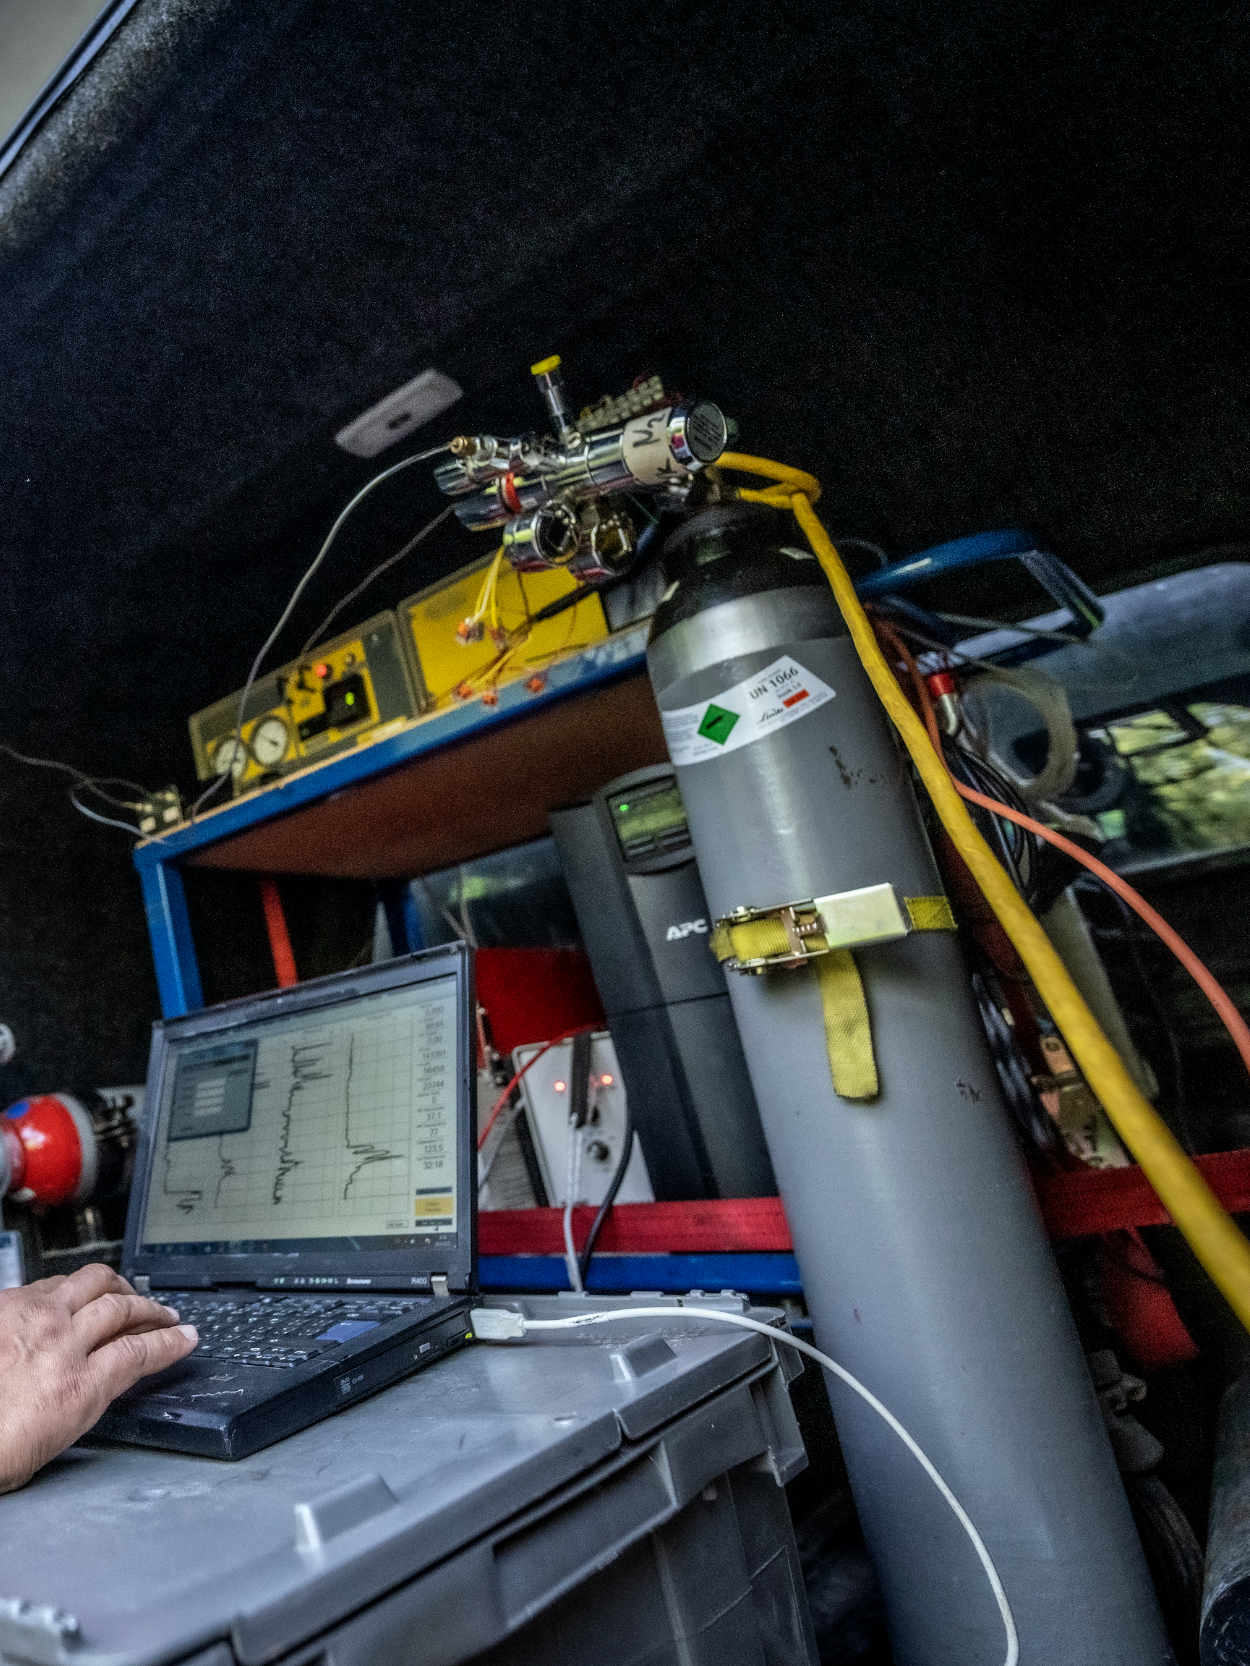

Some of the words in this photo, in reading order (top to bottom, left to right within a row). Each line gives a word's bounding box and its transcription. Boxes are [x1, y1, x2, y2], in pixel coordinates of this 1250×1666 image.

[748, 684, 769, 700] UN
[768, 665, 799, 688] 1066
[666, 918, 708, 941] APC
